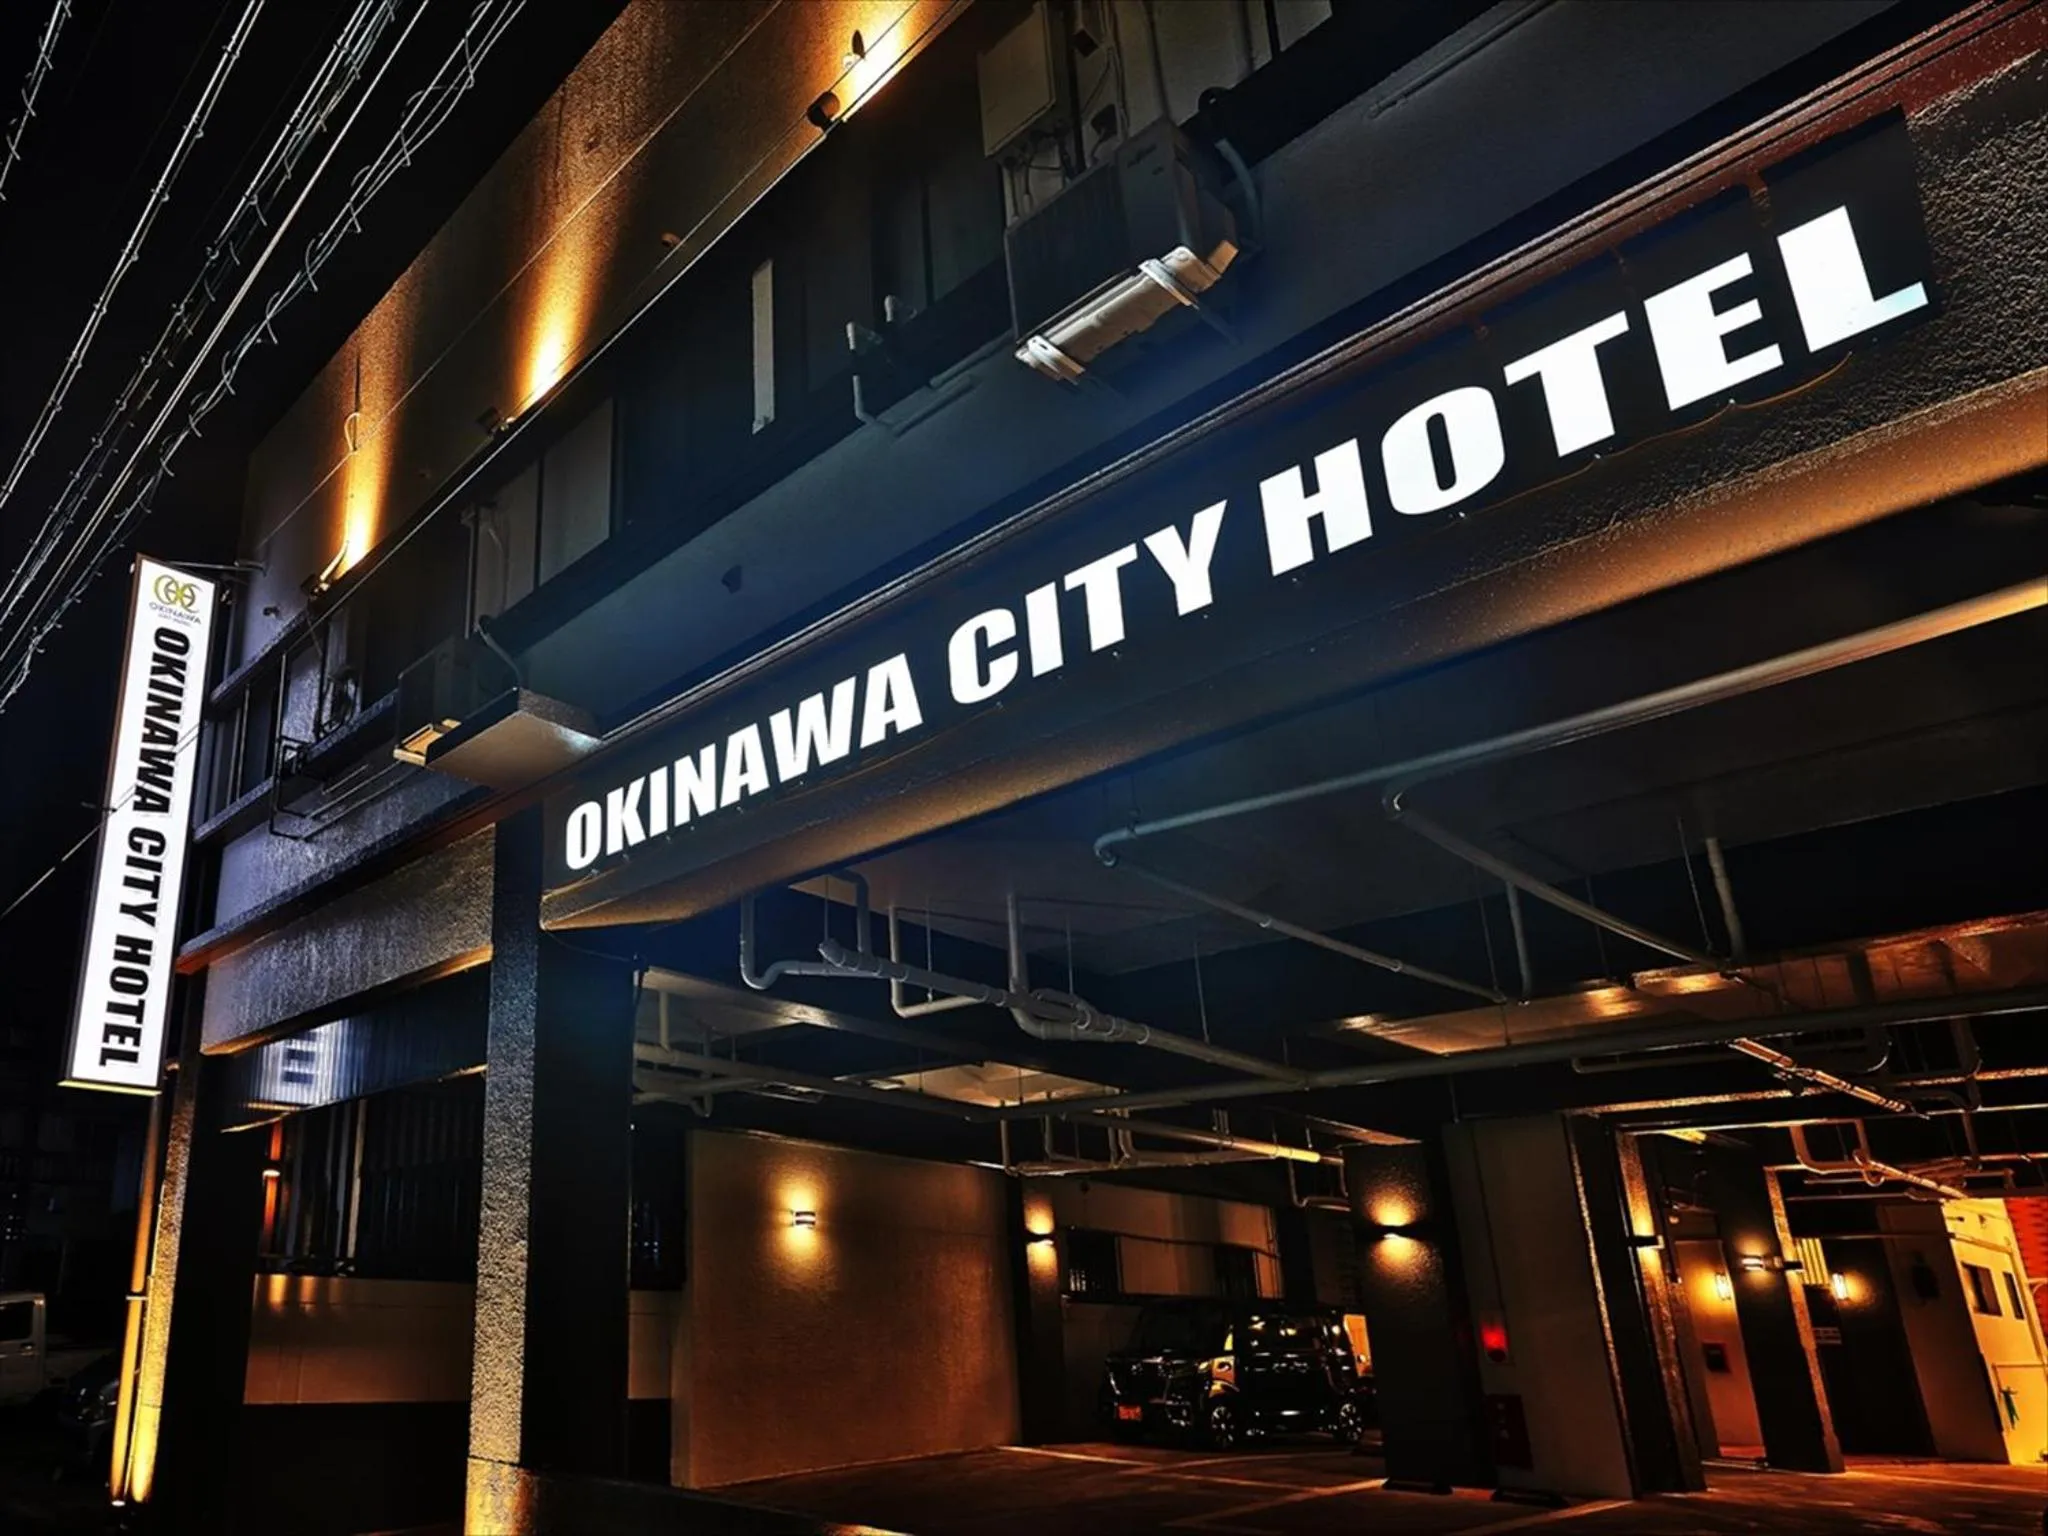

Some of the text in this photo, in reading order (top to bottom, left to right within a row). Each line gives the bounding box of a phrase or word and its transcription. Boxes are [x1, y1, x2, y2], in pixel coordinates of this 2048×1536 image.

[567, 205, 1929, 871] OKINAWA CITY HOTEL
[133, 626, 191, 815] OKINAWA
[119, 826, 167, 929] CITY
[99, 933, 154, 1067] HOTEL
